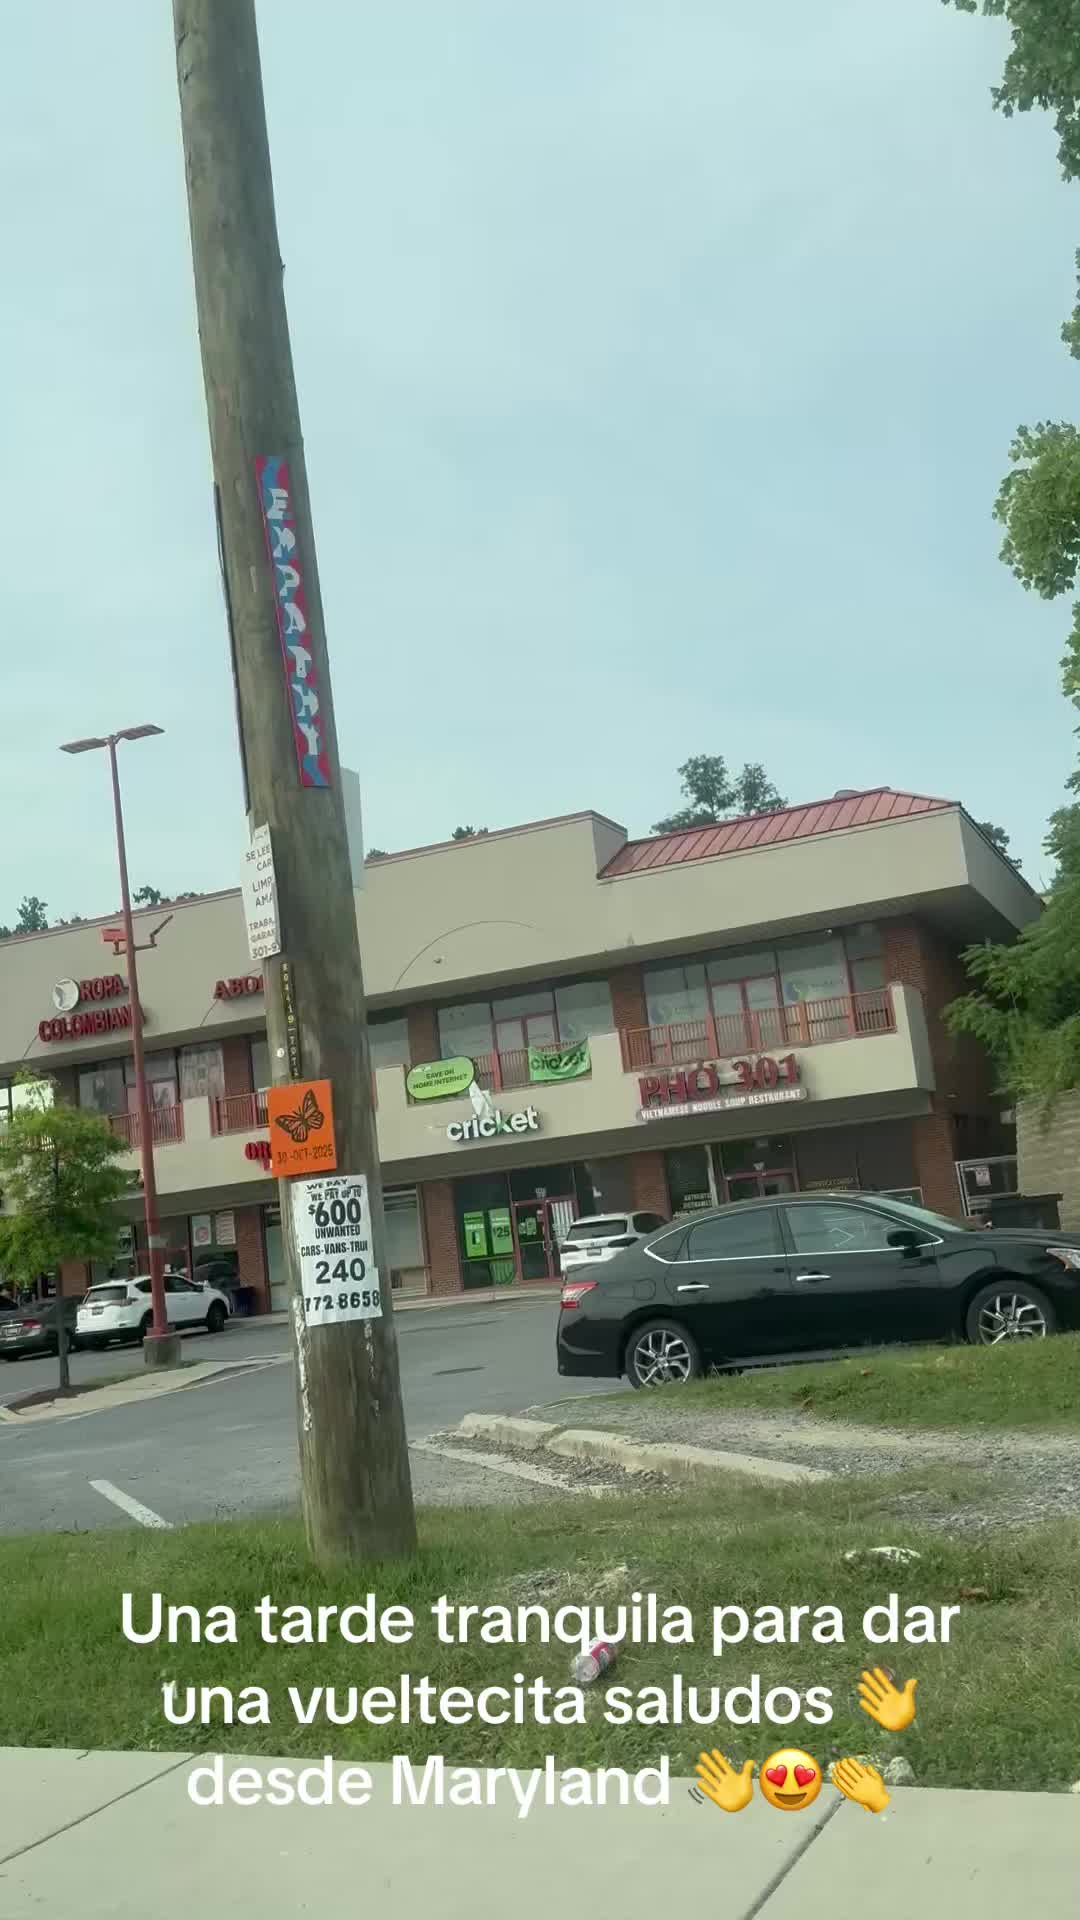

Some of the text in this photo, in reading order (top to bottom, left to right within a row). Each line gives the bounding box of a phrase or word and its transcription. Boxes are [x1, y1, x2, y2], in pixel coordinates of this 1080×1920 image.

[266, 487, 319, 756] EMPATHY
[245, 850, 257, 862] SE
[79, 974, 126, 1001] ROPA
[413, 1073, 468, 1090] HOME INTERNET
[425, 1071, 443, 1080] SAVE
[732, 1053, 801, 1091] 301
[641, 1106, 688, 1121] VIETNAMESE
[749, 1089, 801, 1105] RESTAURANT
[447, 1105, 540, 1142] cricket
[306, 1179, 348, 1191] WE PAY
[311, 1192, 323, 1202] WE
[325, 1190, 339, 1201] PAY
[341, 1189, 352, 1199] UP
[308, 1198, 362, 1228] $600
[315, 1225, 361, 1239] UNWANTED
[315, 1258, 366, 1285] 240
